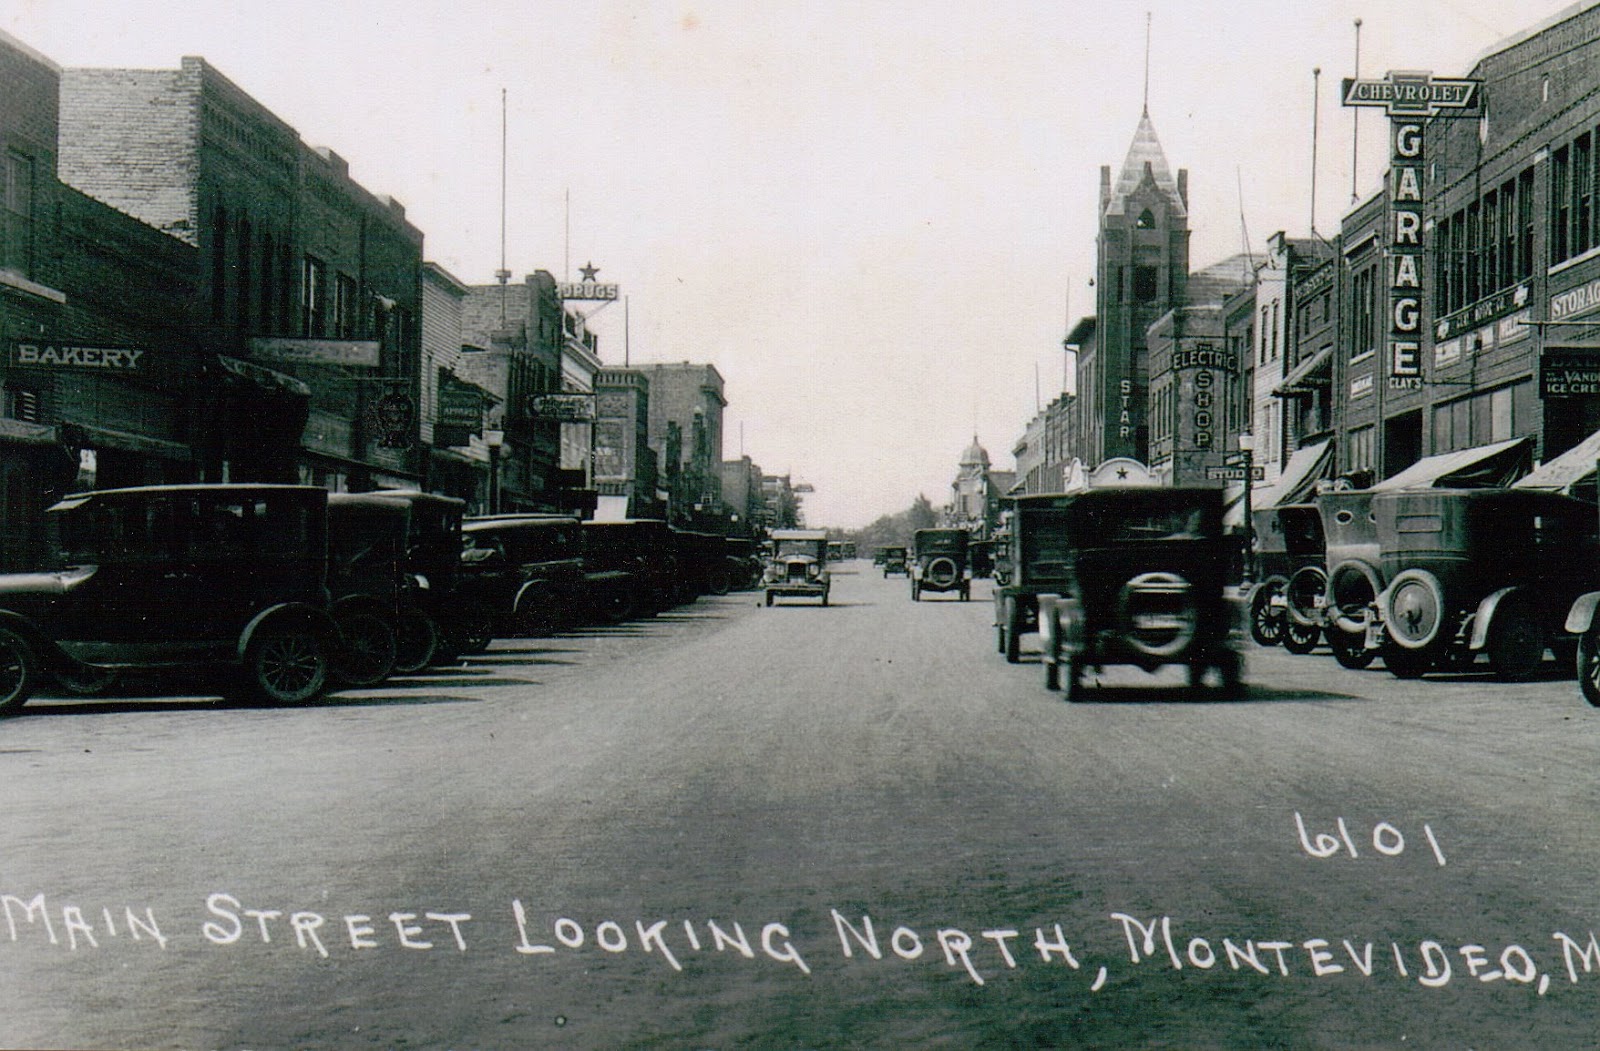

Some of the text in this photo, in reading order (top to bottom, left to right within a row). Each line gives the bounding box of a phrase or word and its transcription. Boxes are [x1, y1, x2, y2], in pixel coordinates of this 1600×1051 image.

[1358, 84, 1463, 101] CHEVROLET
[1394, 124, 1421, 375] GARAGE
[561, 283, 616, 299] DRUGS
[18, 344, 144, 369] BAKERY
[1174, 350, 1237, 371] ELECTRIC
[1388, 377, 1422, 389] CLAY'S
[1564, 370, 1600, 385] VAND
[1547, 383, 1600, 393] ICE CRE
[1120, 380, 1131, 438] STAR
[1196, 371, 1211, 447] SHOP
[1207, 468, 1262, 480] STUDO
